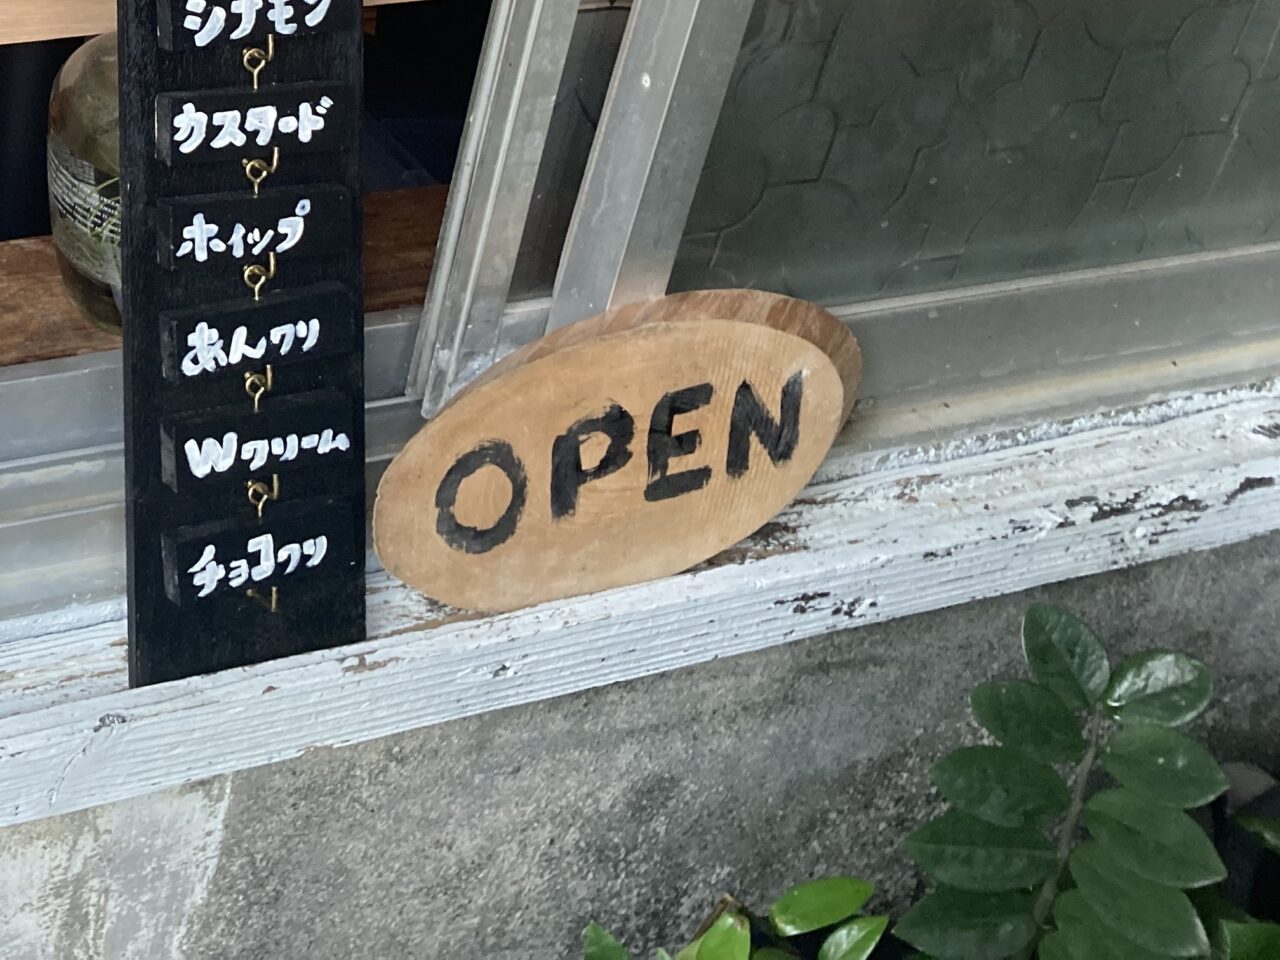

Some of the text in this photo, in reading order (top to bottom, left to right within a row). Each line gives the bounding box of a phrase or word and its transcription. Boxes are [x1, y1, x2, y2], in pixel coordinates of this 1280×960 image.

[173, 96, 333, 153] カスタード
[176, 199, 311, 262] ホイップ
[435, 368, 805, 554] OPEN
